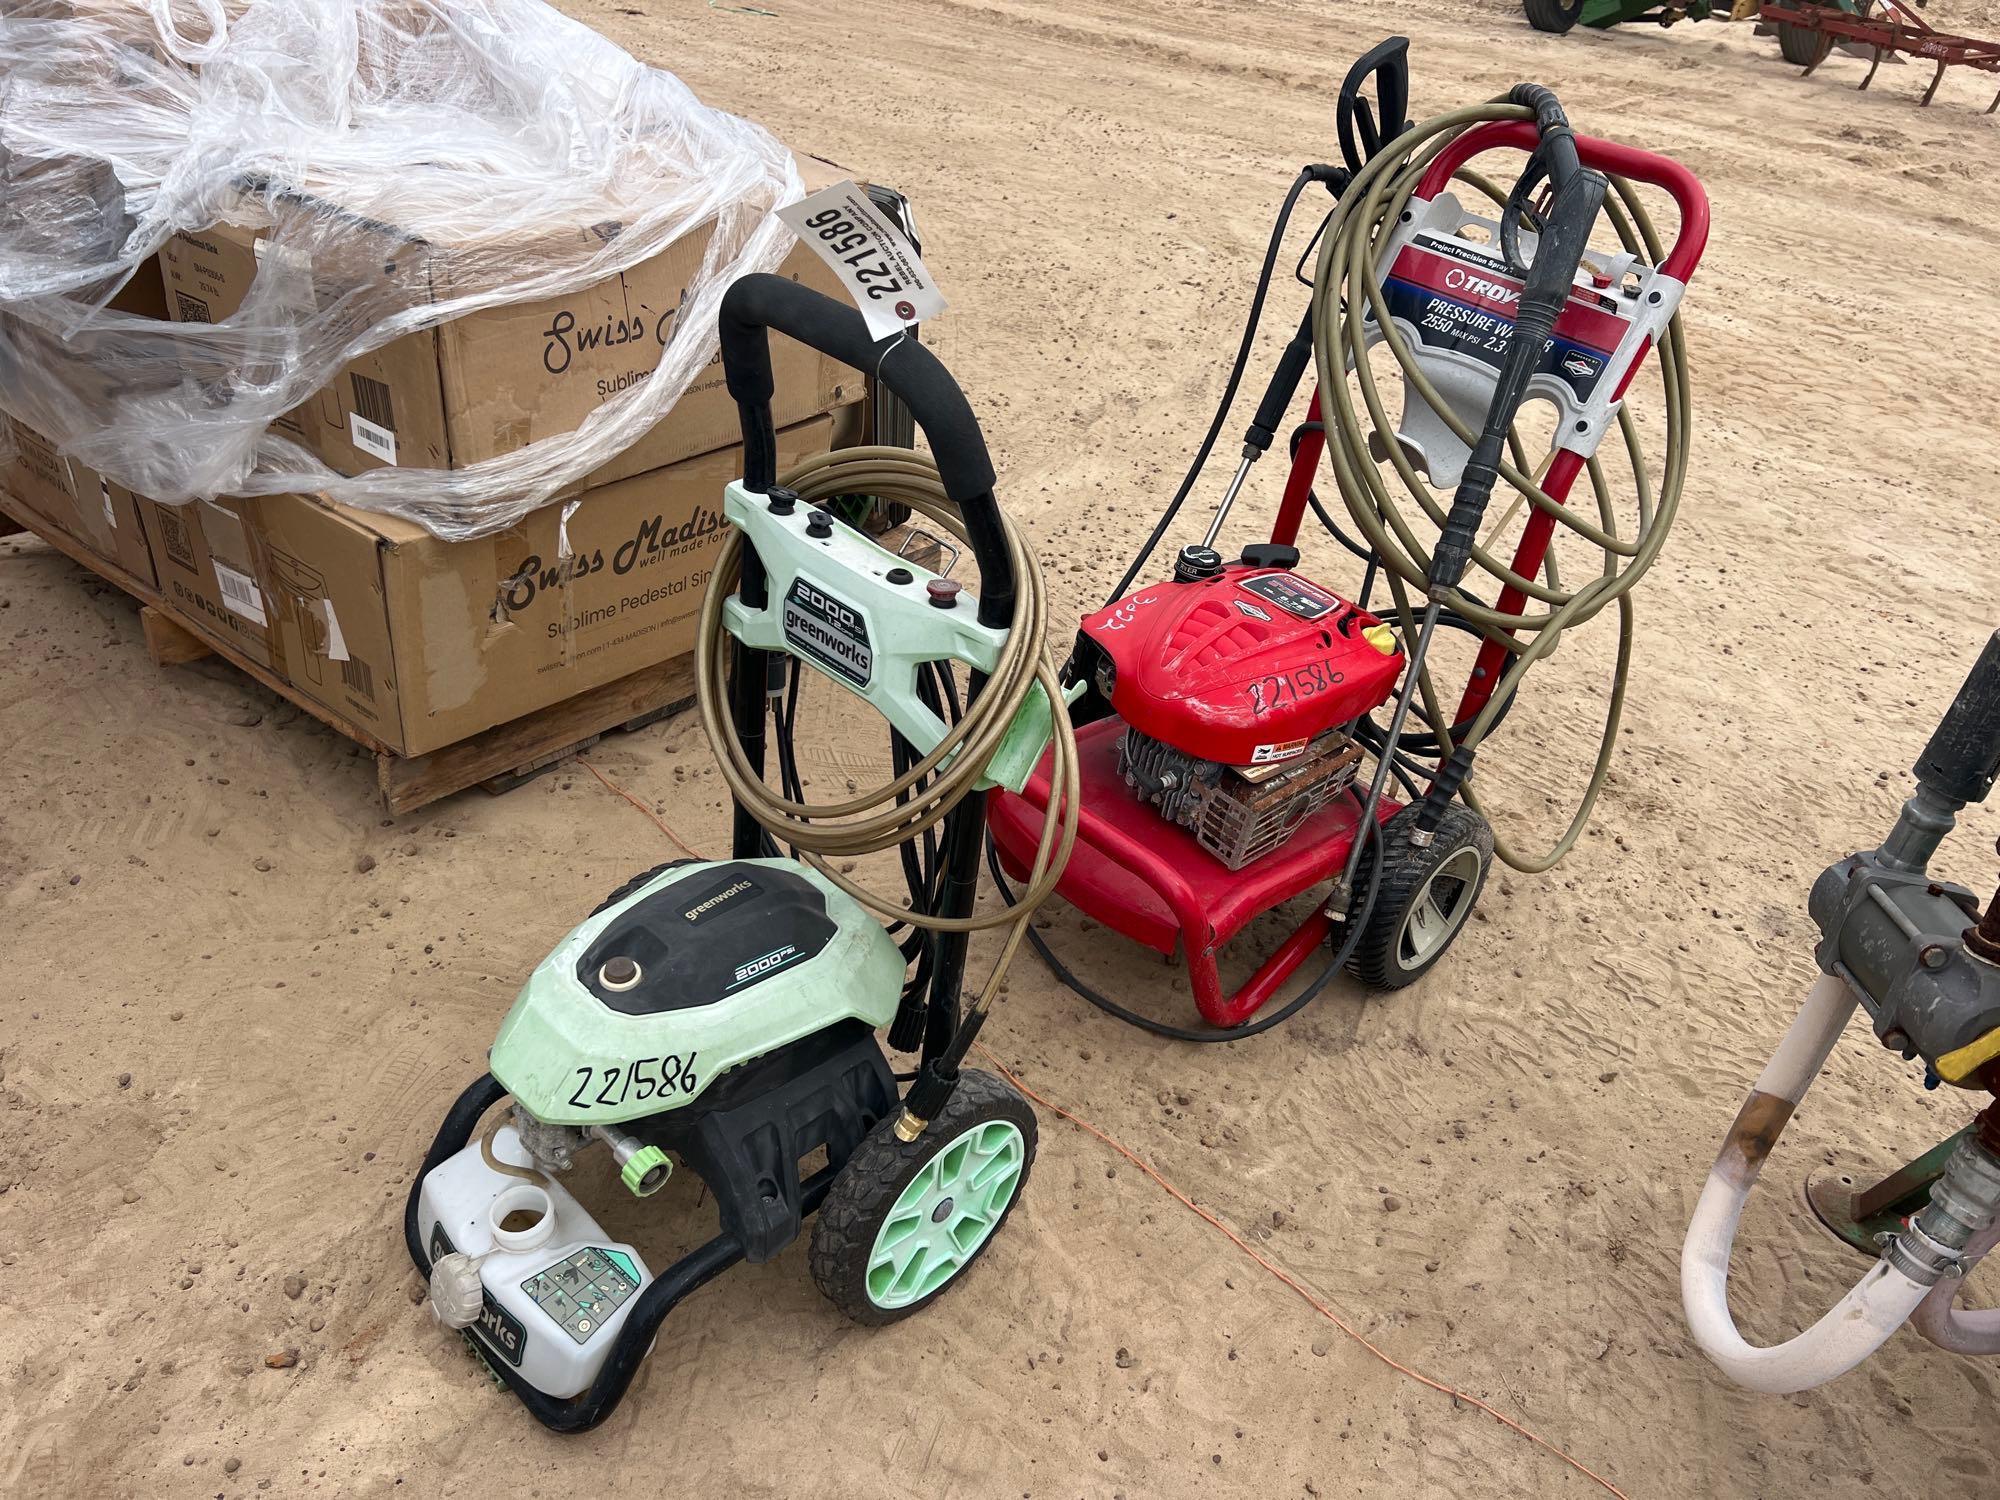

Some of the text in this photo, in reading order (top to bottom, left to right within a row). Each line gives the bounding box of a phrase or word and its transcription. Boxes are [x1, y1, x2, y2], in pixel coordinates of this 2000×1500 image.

[805, 209, 903, 300] 221586
[842, 205, 912, 286] REBEL AUCTION COMPANY
[1430, 241, 1454, 254] Project
[1455, 249, 1487, 265] Precision
[1488, 260, 1508, 273] Spray
[1426, 298, 1496, 332] PRESSURE
[1463, 275, 1521, 307] TROY-
[543, 310, 644, 374] Swiss
[1421, 313, 1507, 353] 2550 MAX PSI 2.3
[507, 505, 731, 611] Swiss Madiso
[639, 551, 666, 568] well
[669, 540, 703, 559] made
[547, 569, 712, 639] Sublime Pedestal Sin
[786, 609, 868, 670] greenworks
[1246, 660, 1345, 715] 221586
[685, 878, 752, 921] greenworks
[568, 1051, 697, 1110] 221586
